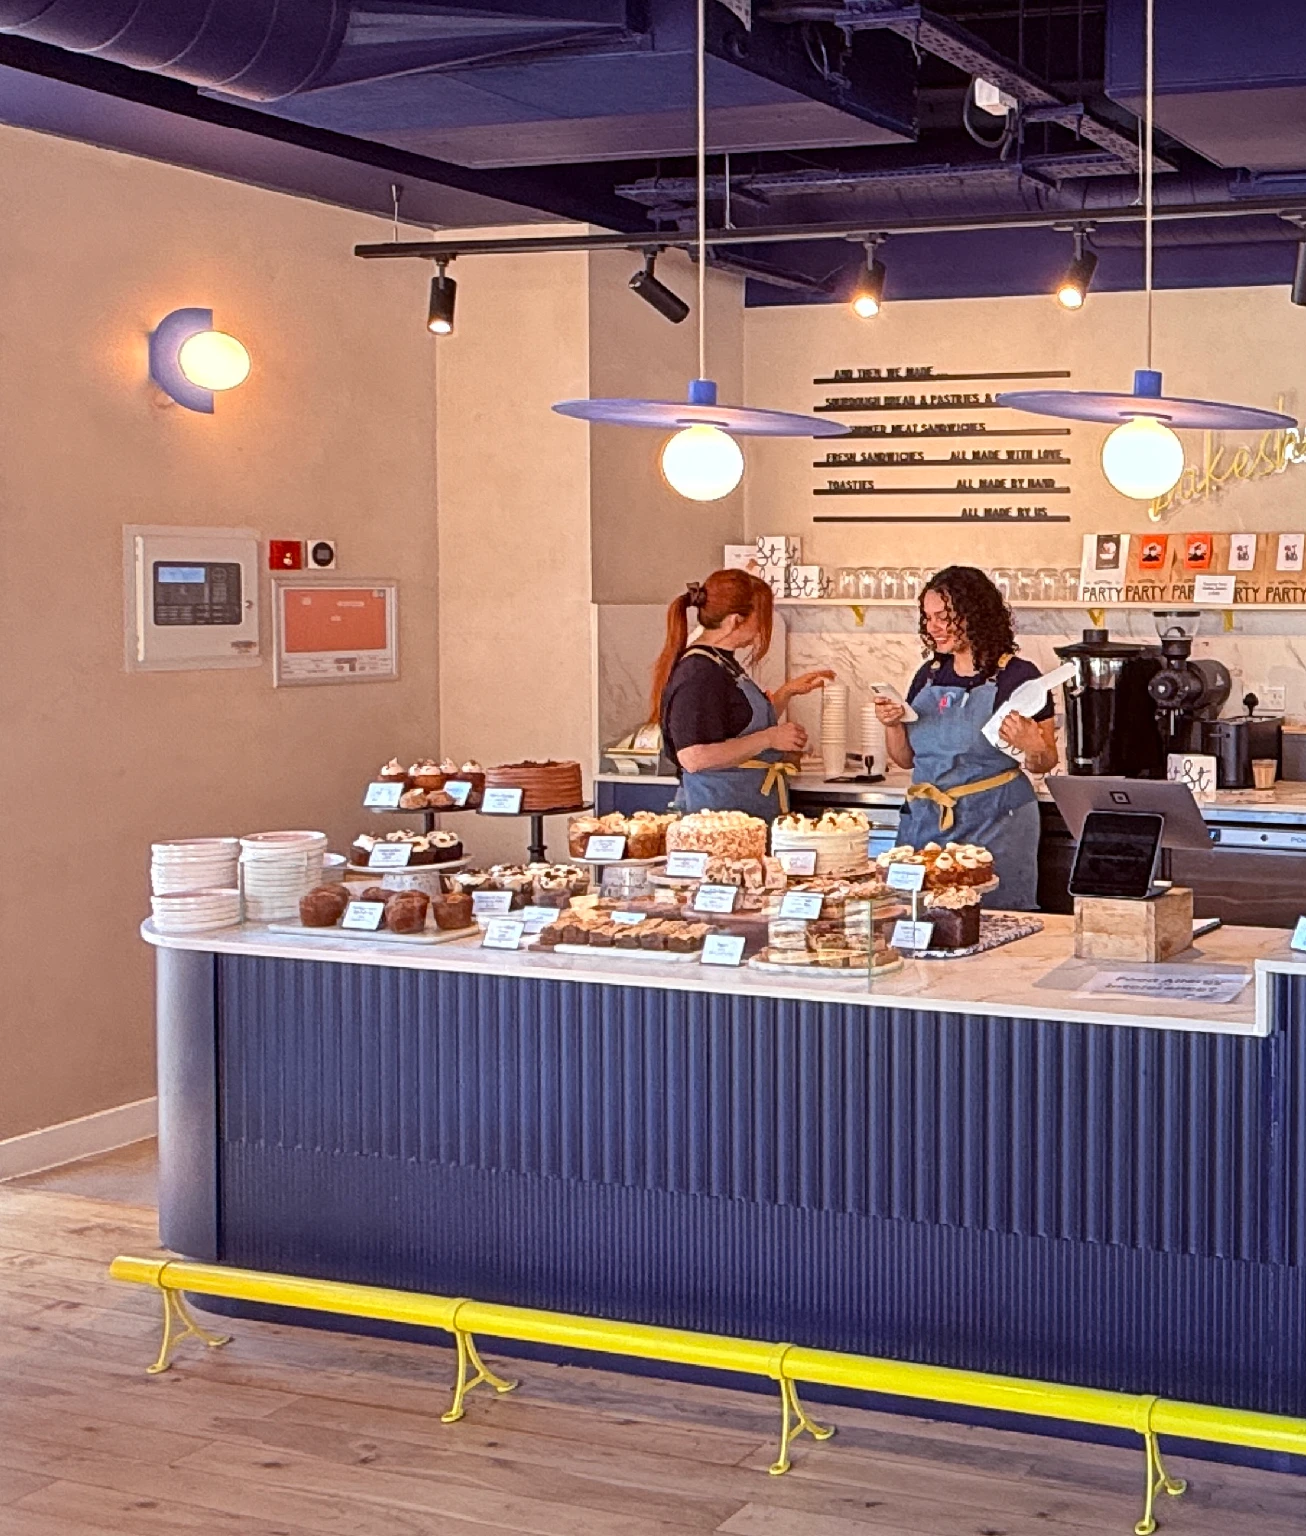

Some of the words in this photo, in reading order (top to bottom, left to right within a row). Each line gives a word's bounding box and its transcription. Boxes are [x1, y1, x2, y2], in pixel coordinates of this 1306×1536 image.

[930, 394, 980, 404] PASTRIES
[921, 423, 986, 433] SANDWICHES
[826, 452, 856, 462] FRESH
[860, 451, 924, 462] SANDWICHES
[950, 450, 967, 460] ALL
[972, 450, 1001, 460] MADE
[1006, 449, 1032, 460] WITH
[1037, 449, 1063, 459] LOVE
[827, 480, 874, 490] TOASTIES
[956, 479, 973, 489] ALL
[978, 478, 1006, 489] MADE
[1011, 478, 1024, 488] BY
[1027, 478, 1056, 488] HAND
[961, 507, 978, 517] ALL
[984, 507, 1012, 517] MADE
[1017, 507, 1031, 517] BY
[1034, 507, 1048, 517] US
[1083, 586, 1123, 601] PARTY
[1126, 585, 1166, 600] PARTY
[1172, 585, 1194, 600] PAR
[1236, 586, 1260, 602] RTY
[1266, 586, 1306, 602] PARTY
